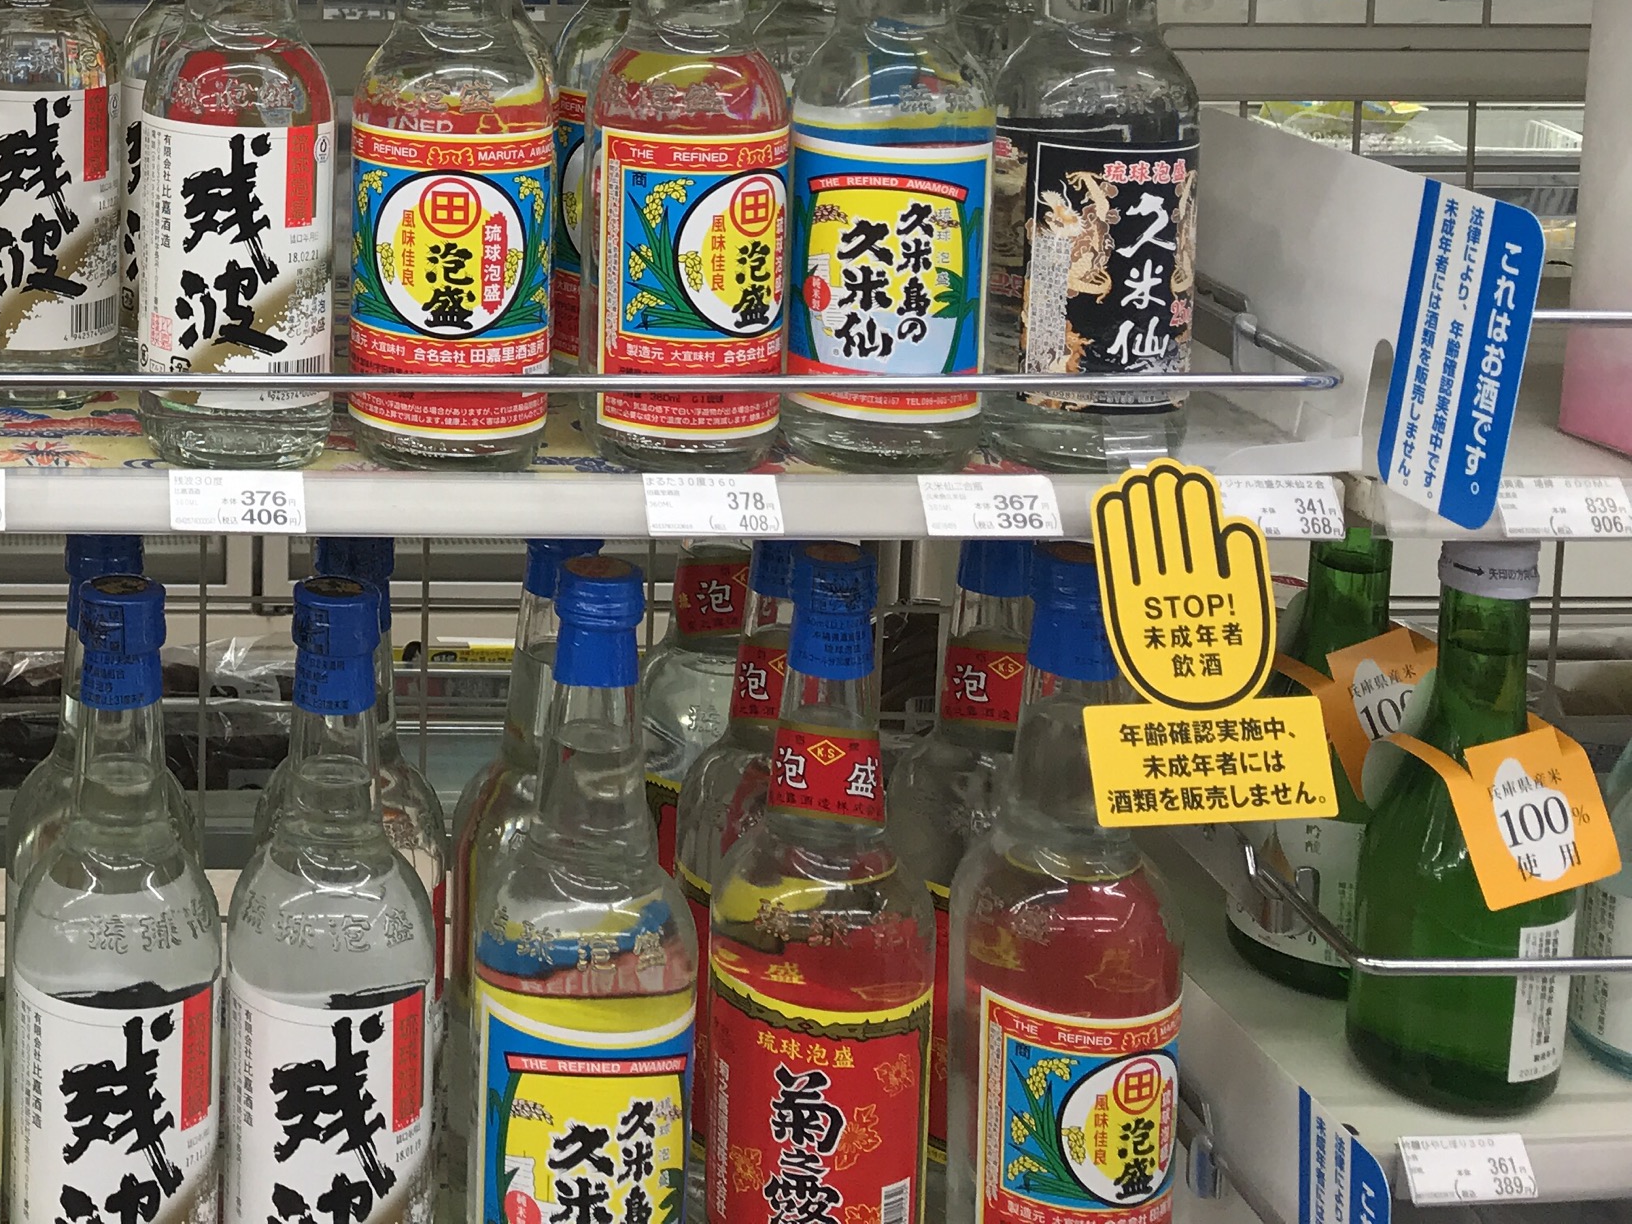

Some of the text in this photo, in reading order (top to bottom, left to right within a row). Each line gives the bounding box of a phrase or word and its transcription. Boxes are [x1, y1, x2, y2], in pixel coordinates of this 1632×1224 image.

[374, 142, 525, 161] REFINED MARUTA
[628, 147, 729, 164] THE REFINED
[160, 134, 172, 249] 有限会社比嘉酒造
[818, 176, 960, 198] THE REFINED AWAMORI
[1102, 162, 1187, 185] 琉球泡盛
[400, 210, 416, 287] 風味佳良
[482, 222, 504, 305] 琉球泡盛
[710, 214, 726, 292] 風味佳良
[423, 243, 477, 331] 泡盛
[730, 239, 774, 328] 泡盛
[835, 217, 894, 360] 久米仙
[894, 200, 935, 345] 久米島の
[1107, 192, 1178, 363] 久米仙
[371, 341, 544, 363] 大宜味村 合名会社 田嘉里酒造所
[626, 343, 765, 365] 製造元 大宜味村 合名会社
[1399, 197, 1460, 488] 未成年者には酒類を販売しません。
[1466, 238, 1522, 497] これはお酒です。
[1143, 595, 1238, 620] STOP!
[1143, 623, 1244, 650] 未成年者
[1171, 652, 1224, 678] 飲酒
[1346, 665, 1417, 702] 兵庫県産米
[1118, 717, 1299, 748] 年齢確認実施中、
[1142, 751, 1287, 778] 未成年者には
[1107, 785, 1329, 817] 酒類を販売しません。
[1486, 769, 1563, 804] 兵庫県産米
[757, 1031, 856, 1070] 琉球泡盛
[1012, 1018, 1113, 1047] THE REFINED
[31, 1010, 43, 1129] 有限会社比嘉酒造
[242, 1008, 254, 1127] 有限会社比嘉酒造
[520, 1057, 685, 1075] THE REFINED AWAMORI
[1093, 1092, 1109, 1167] 風味佳良
[1112, 1118, 1157, 1202] 泡盛
